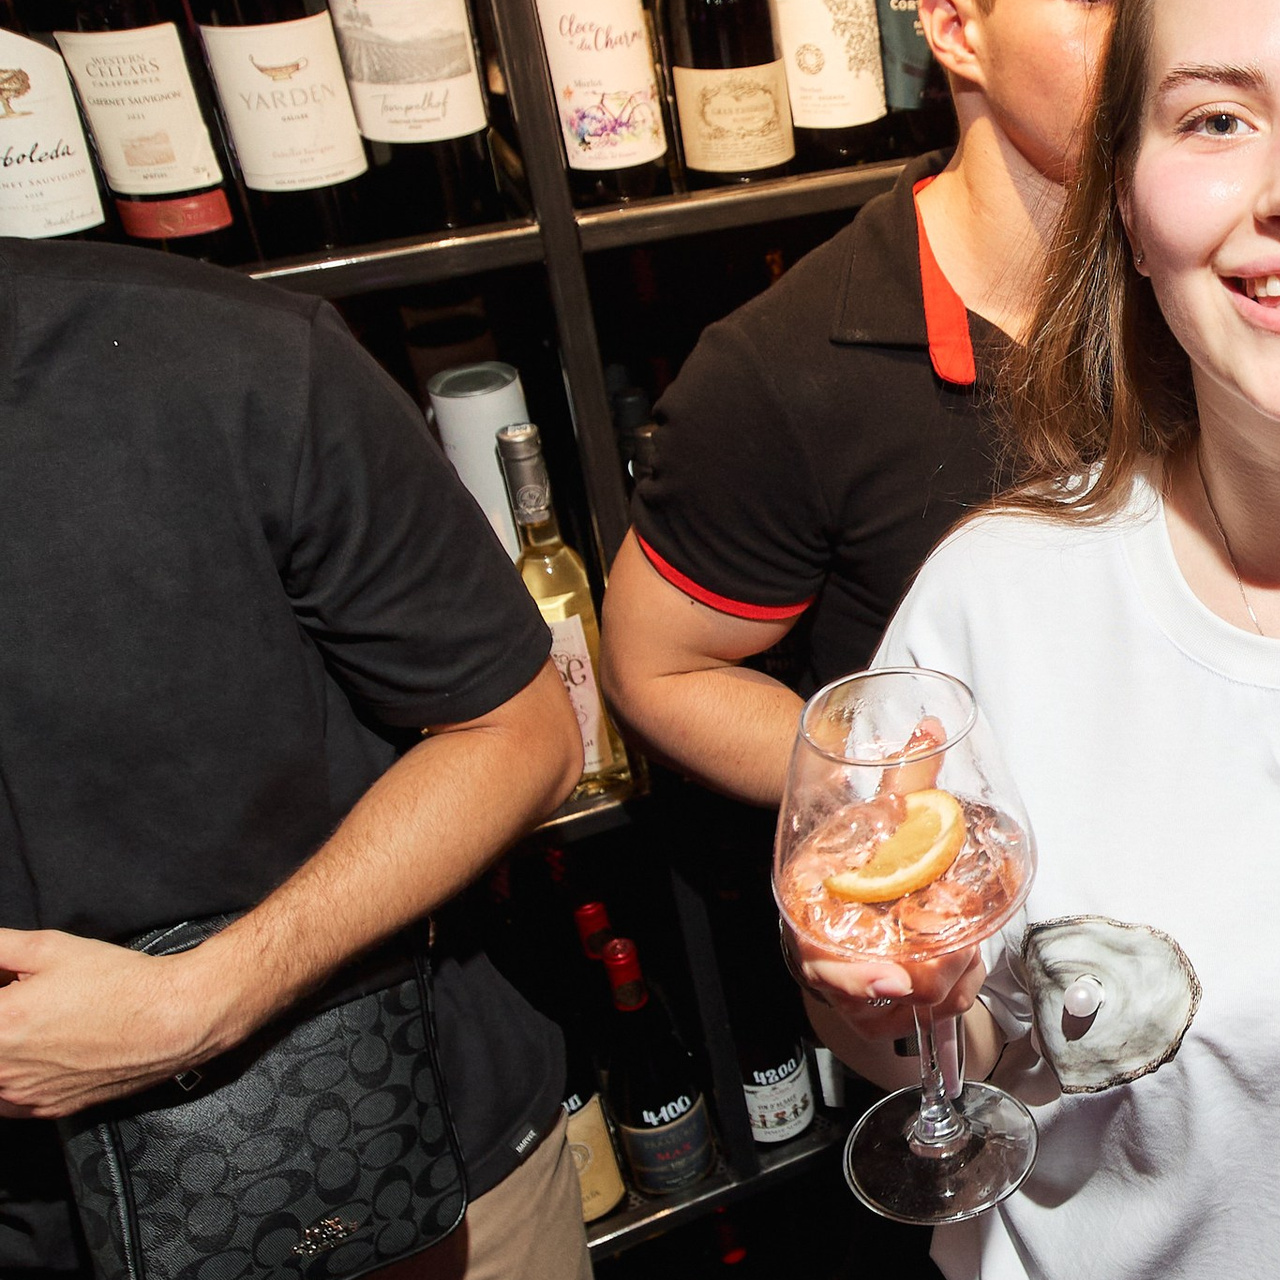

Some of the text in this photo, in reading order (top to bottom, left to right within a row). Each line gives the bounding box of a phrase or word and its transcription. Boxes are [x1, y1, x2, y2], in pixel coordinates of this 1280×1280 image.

[85, 58, 161, 78] CELLARS
[90, 53, 145, 66] WESTERN
[92, 77, 162, 88] CALIFORNIA
[87, 90, 183, 107] CABERNET SAUVIGNON
[240, 83, 337, 111] YARDEN
[28, 168, 87, 188] SAUVIGNON
[752, 1058, 797, 1086] 4200
